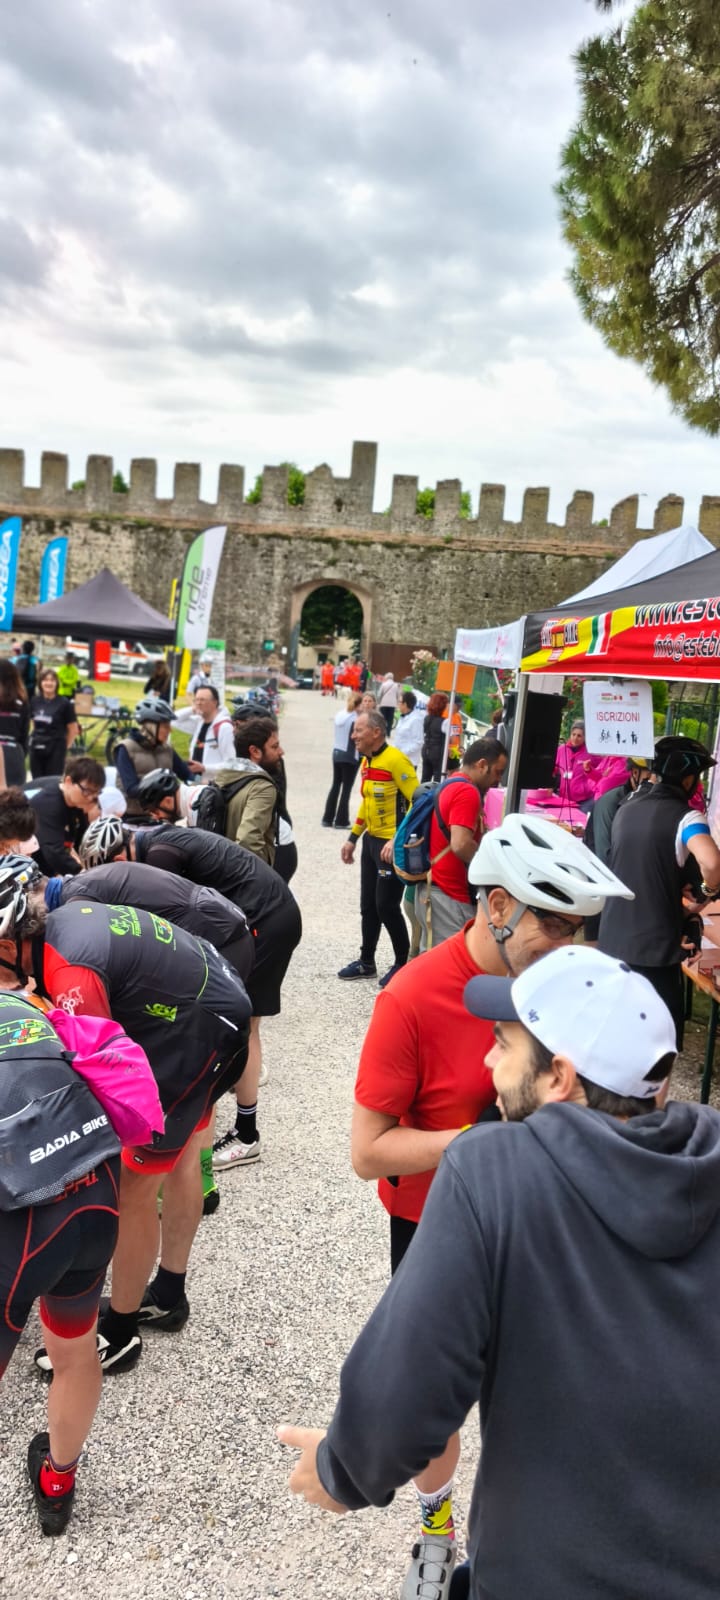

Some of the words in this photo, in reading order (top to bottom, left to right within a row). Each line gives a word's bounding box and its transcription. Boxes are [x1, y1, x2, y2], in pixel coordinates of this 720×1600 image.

[187, 566, 205, 625] ride
[634, 598, 720, 628] www.est
[596, 711, 641, 722] ISCRIZIONI
[29, 1130, 81, 1165] BADIA
[82, 1114, 109, 1135] BIKE
